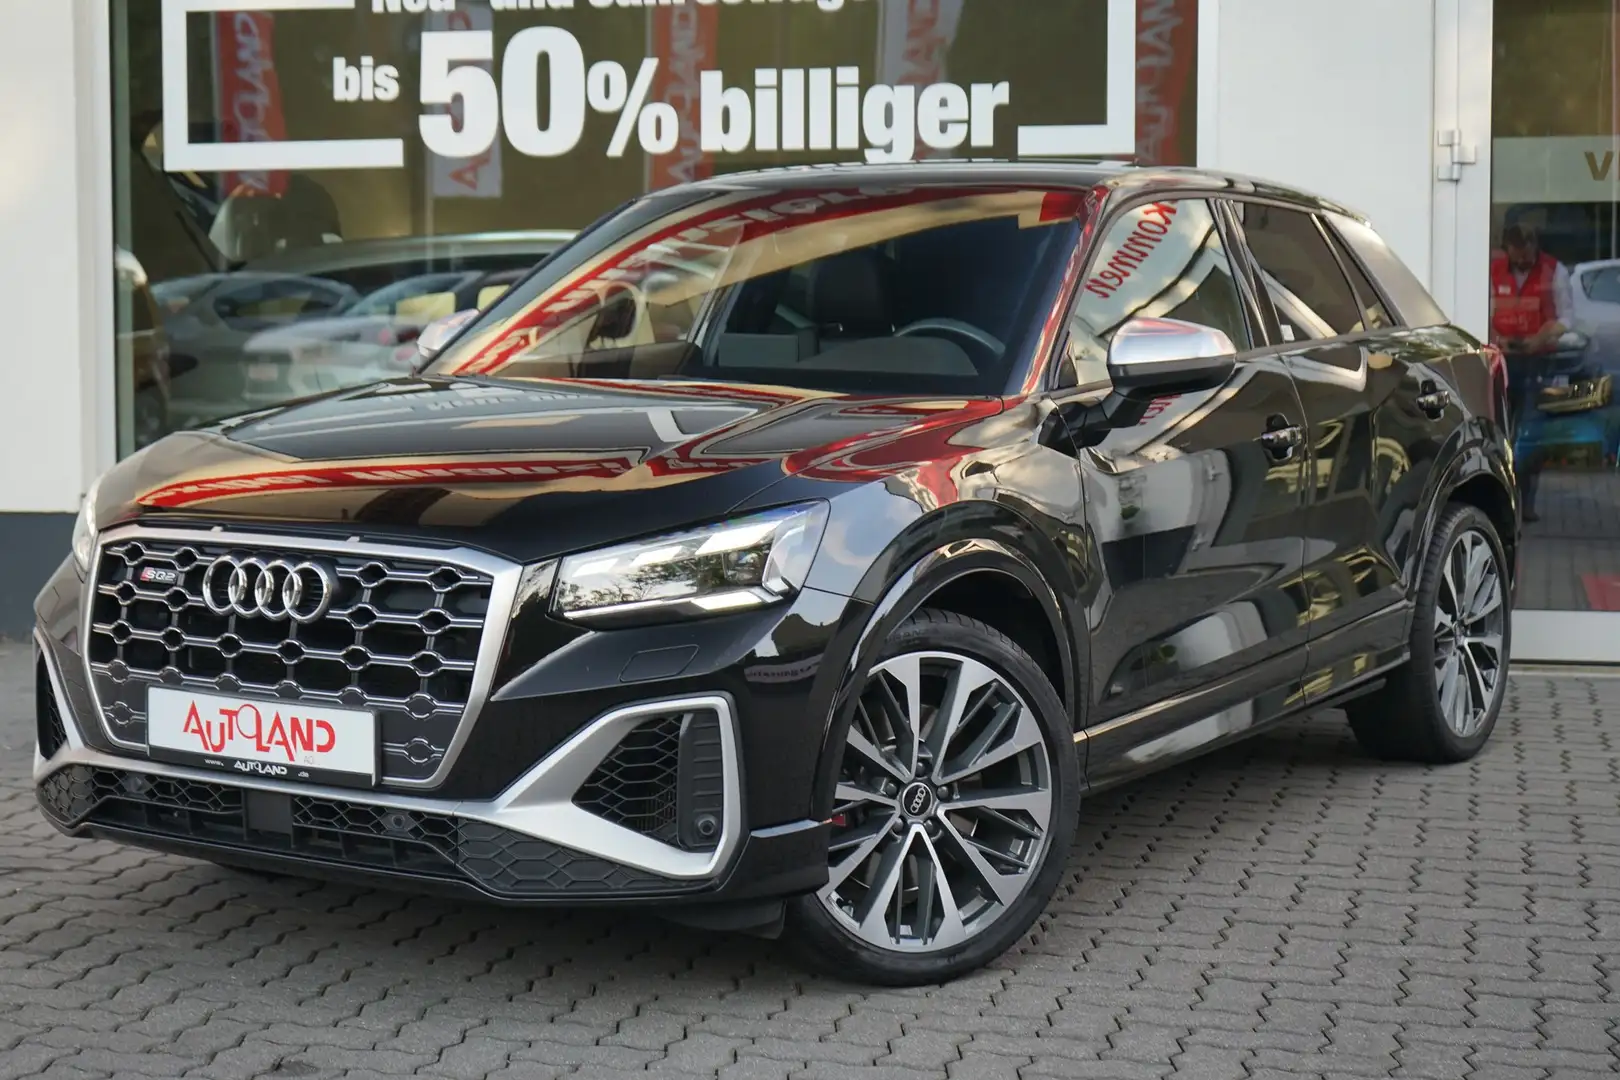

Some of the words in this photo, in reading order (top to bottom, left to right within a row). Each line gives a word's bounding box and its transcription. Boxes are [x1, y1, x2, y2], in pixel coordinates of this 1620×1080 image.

[333, 56, 400, 101] bis
[418, 26, 680, 158] 50%
[700, 66, 1010, 164] billiger
[146, 569, 176, 582] SQ2
[183, 700, 336, 762] AUTOLAND
[233, 760, 288, 776] AUTOLAND
